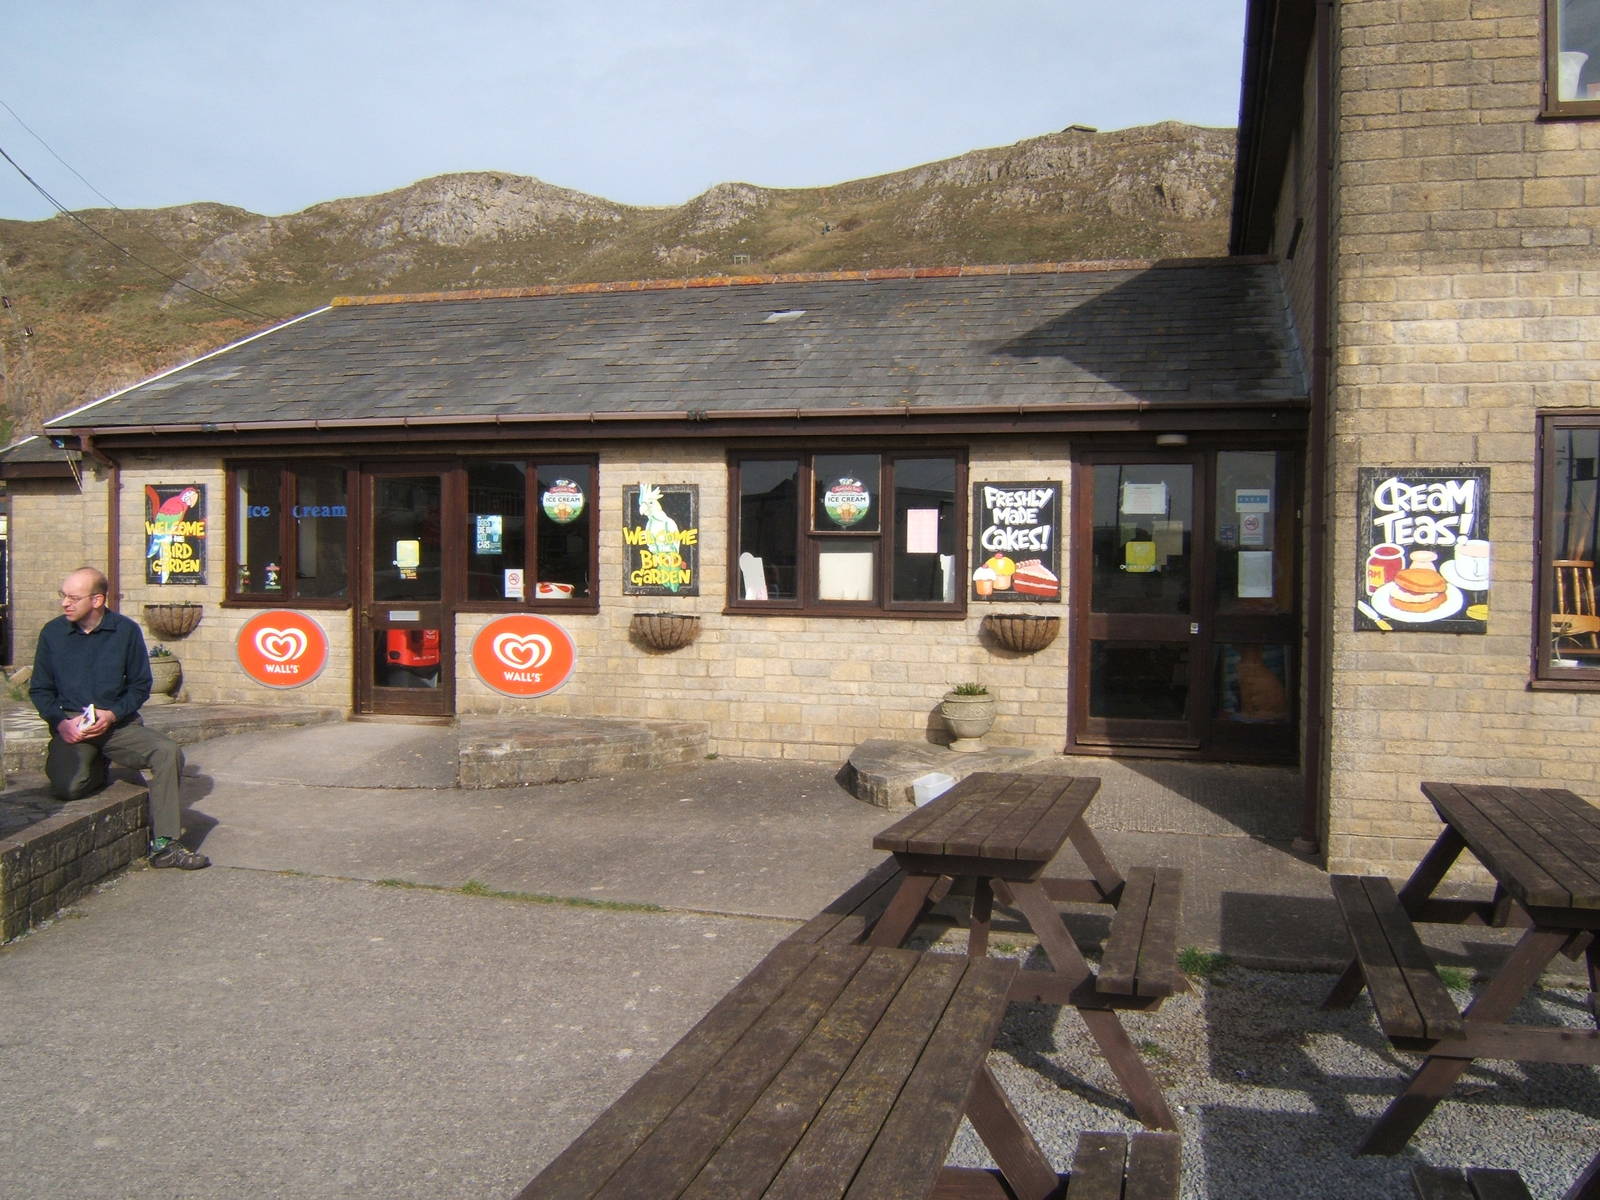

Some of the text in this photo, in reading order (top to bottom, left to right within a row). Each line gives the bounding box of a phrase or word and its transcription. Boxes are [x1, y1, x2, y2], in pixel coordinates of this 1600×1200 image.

[984, 486, 1054, 509] FRESHLY
[145, 521, 205, 536] WELCOME
[623, 526, 698, 545] WELCOME
[264, 663, 299, 674] WALL'S
[503, 671, 541, 683] WALL'S
